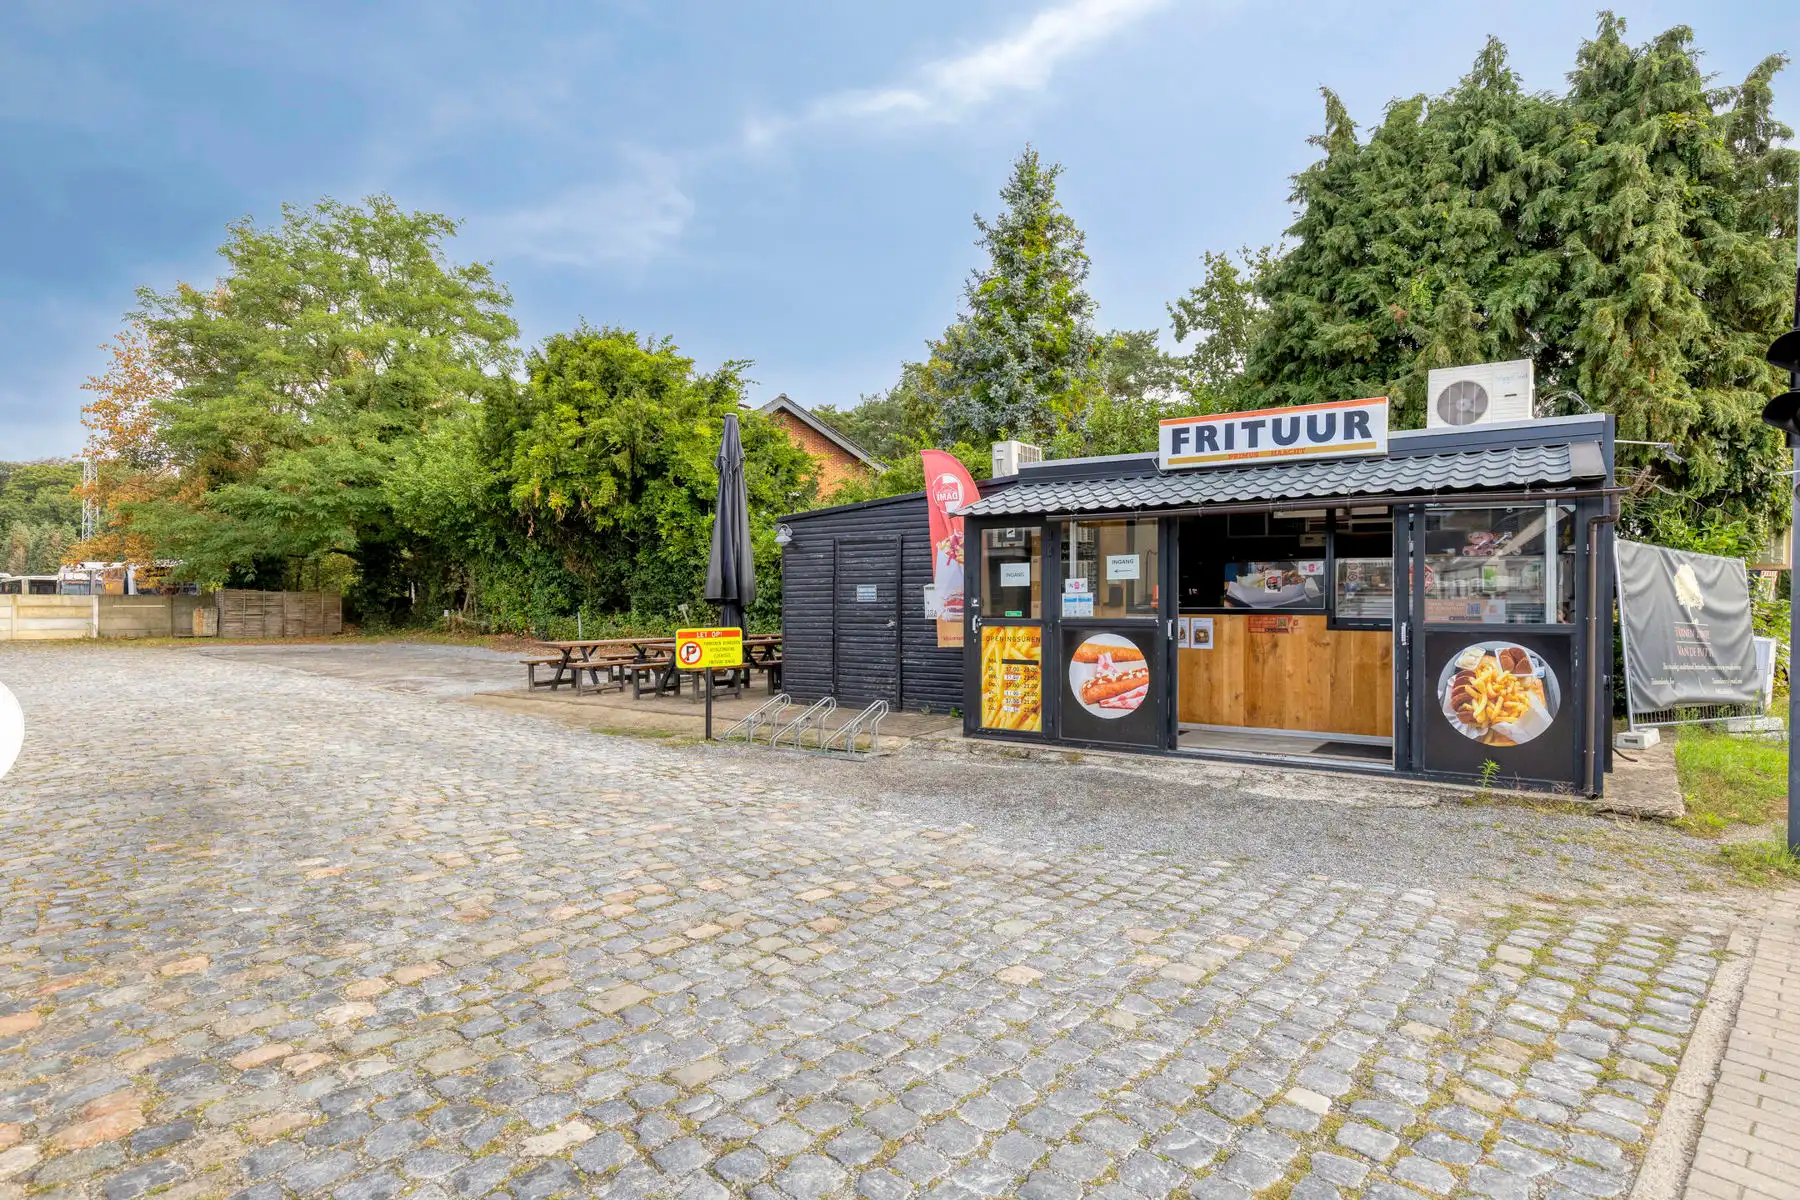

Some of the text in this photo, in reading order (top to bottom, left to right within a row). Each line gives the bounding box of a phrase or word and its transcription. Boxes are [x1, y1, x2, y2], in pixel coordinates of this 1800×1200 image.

[1172, 410, 1373, 455] FRITUUR
[1227, 451, 1260, 461] PRIMUS
[696, 631, 708, 639] LET
[985, 635, 1041, 643] OPENINGSUREN
